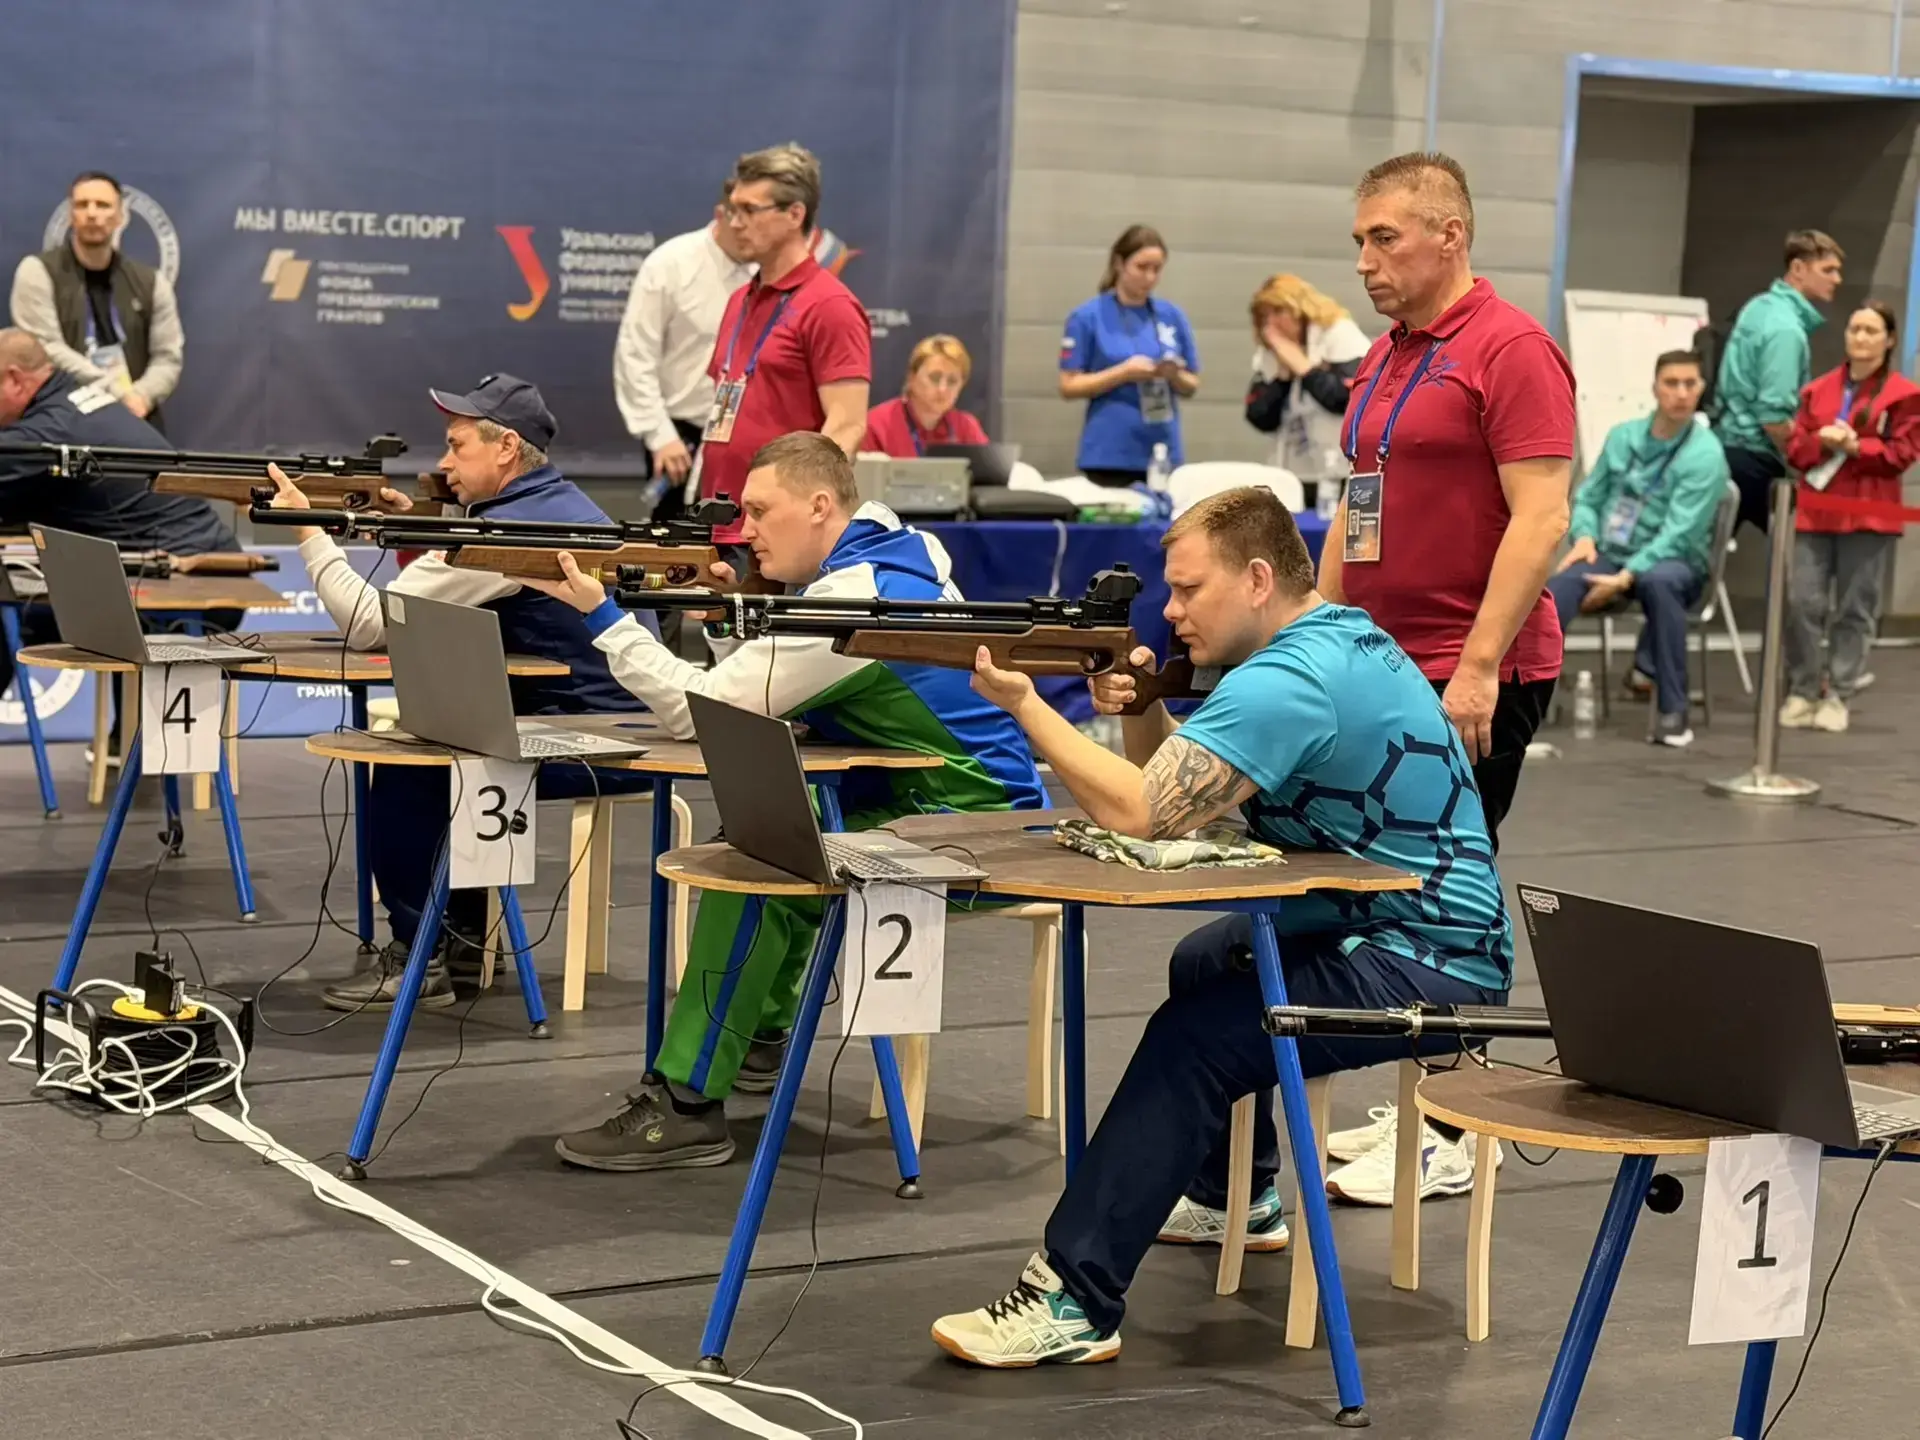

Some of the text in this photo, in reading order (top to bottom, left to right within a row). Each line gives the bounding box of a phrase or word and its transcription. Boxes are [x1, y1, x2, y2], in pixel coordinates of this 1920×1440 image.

[235, 207, 465, 240] МЫ ВМЕСТЕ.СПОРТ
[163, 687, 197, 734] 4
[476, 785, 509, 842] 3
[874, 913, 913, 981] 2
[1737, 1180, 1777, 1269] 1
